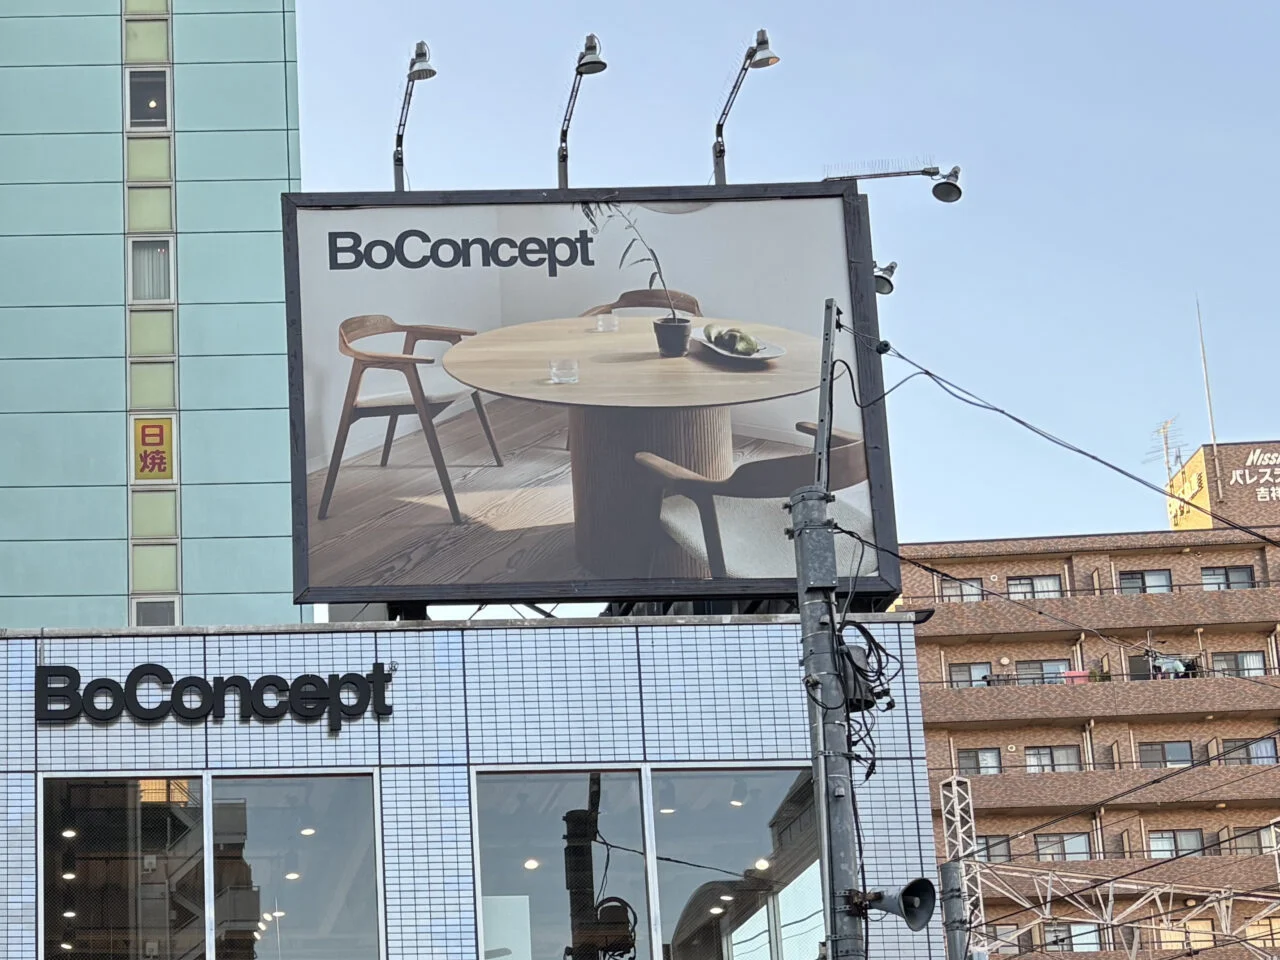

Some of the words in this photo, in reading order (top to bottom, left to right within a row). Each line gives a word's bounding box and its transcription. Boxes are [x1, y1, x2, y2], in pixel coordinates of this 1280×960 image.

[327, 229, 595, 277] BoConcept
[1245, 448, 1280, 467] NISS
[35, 662, 393, 732] BoConcept
